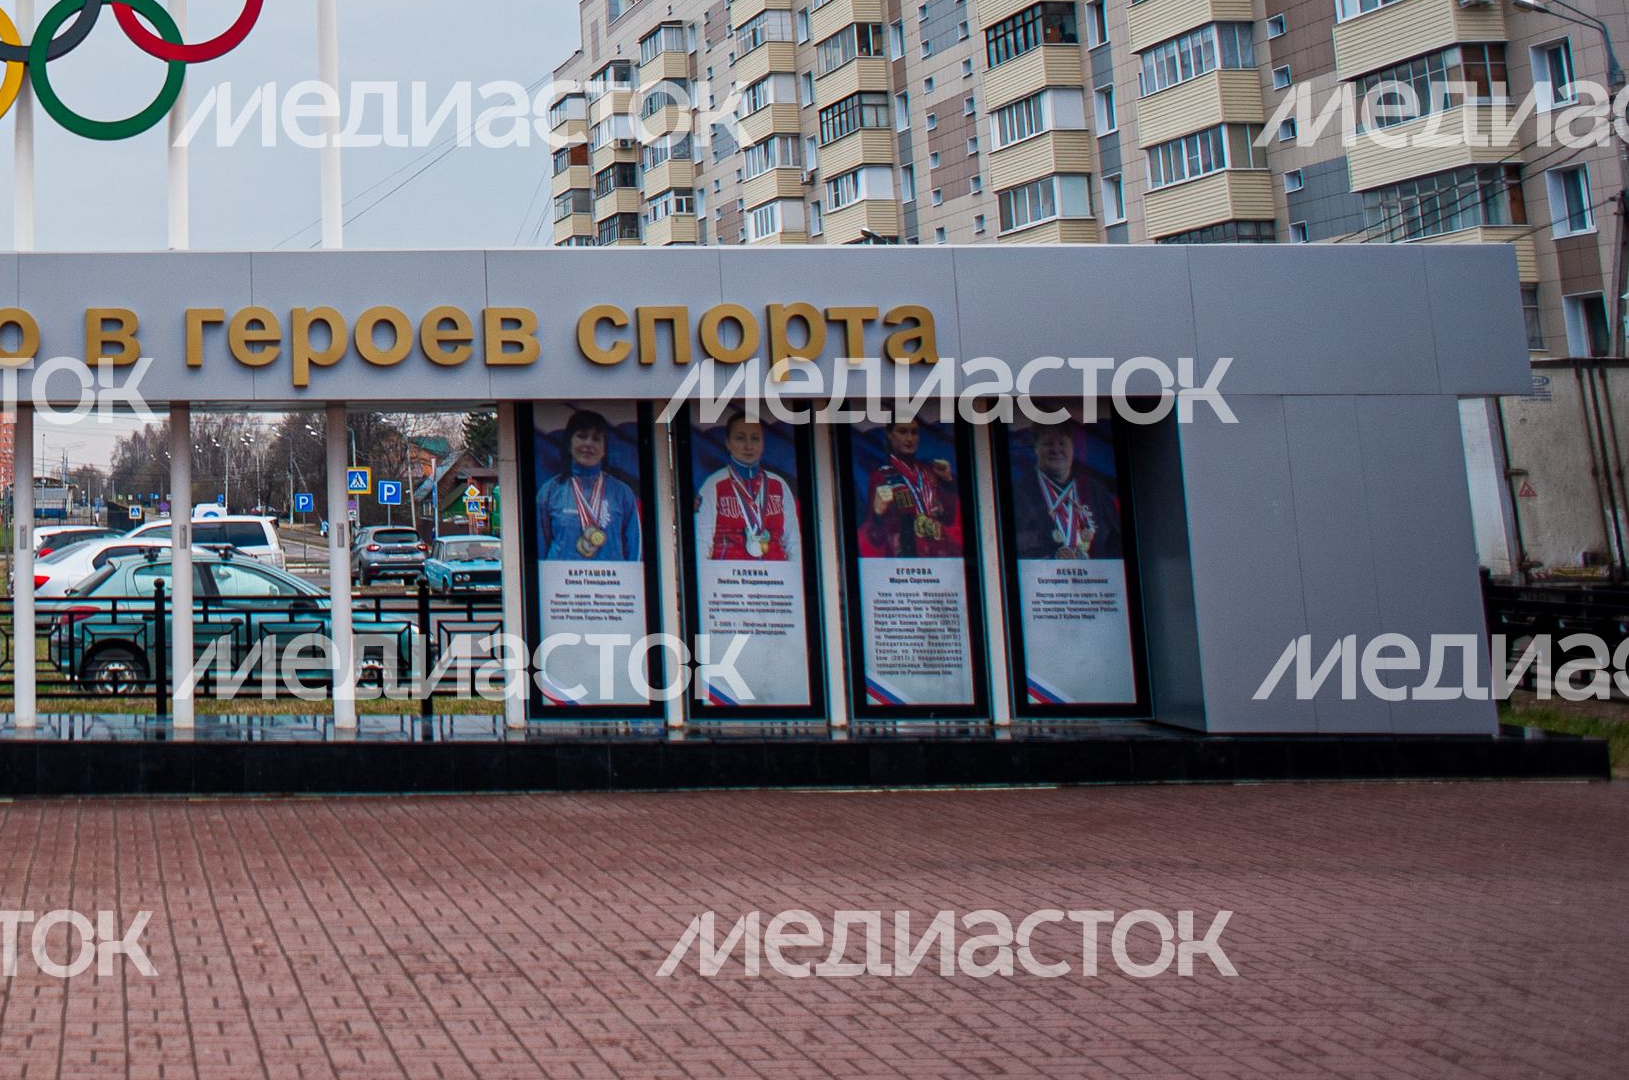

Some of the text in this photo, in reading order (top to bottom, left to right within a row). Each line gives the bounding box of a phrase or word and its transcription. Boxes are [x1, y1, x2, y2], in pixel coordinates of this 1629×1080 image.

[85, 307, 141, 367] в
[186, 305, 541, 387] героев
[577, 302, 940, 383] спорта
[568, 569, 617, 577] КАРТАШОВА
[896, 567, 932, 575] ЕГОРОВА
